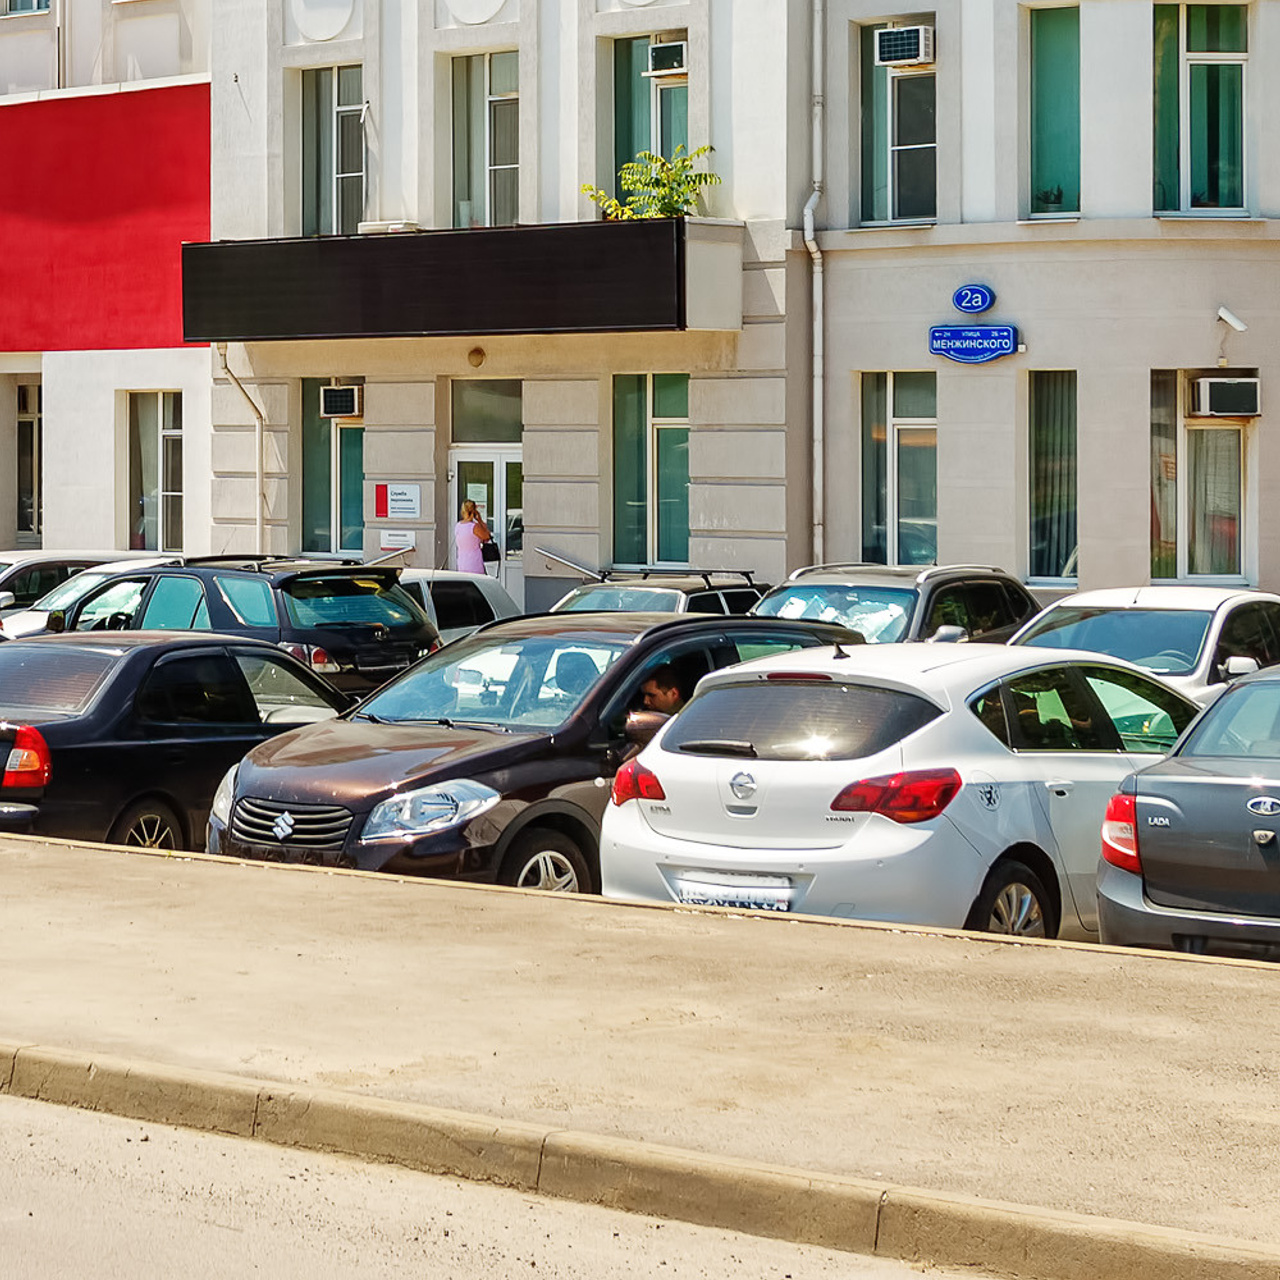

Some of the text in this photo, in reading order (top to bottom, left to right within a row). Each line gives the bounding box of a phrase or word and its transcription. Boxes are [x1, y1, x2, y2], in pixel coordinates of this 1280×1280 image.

[961, 290, 982, 306] 2а
[933, 339, 1010, 349] МЕНЖИНСКОГО
[1148, 816, 1170, 827] LADA
